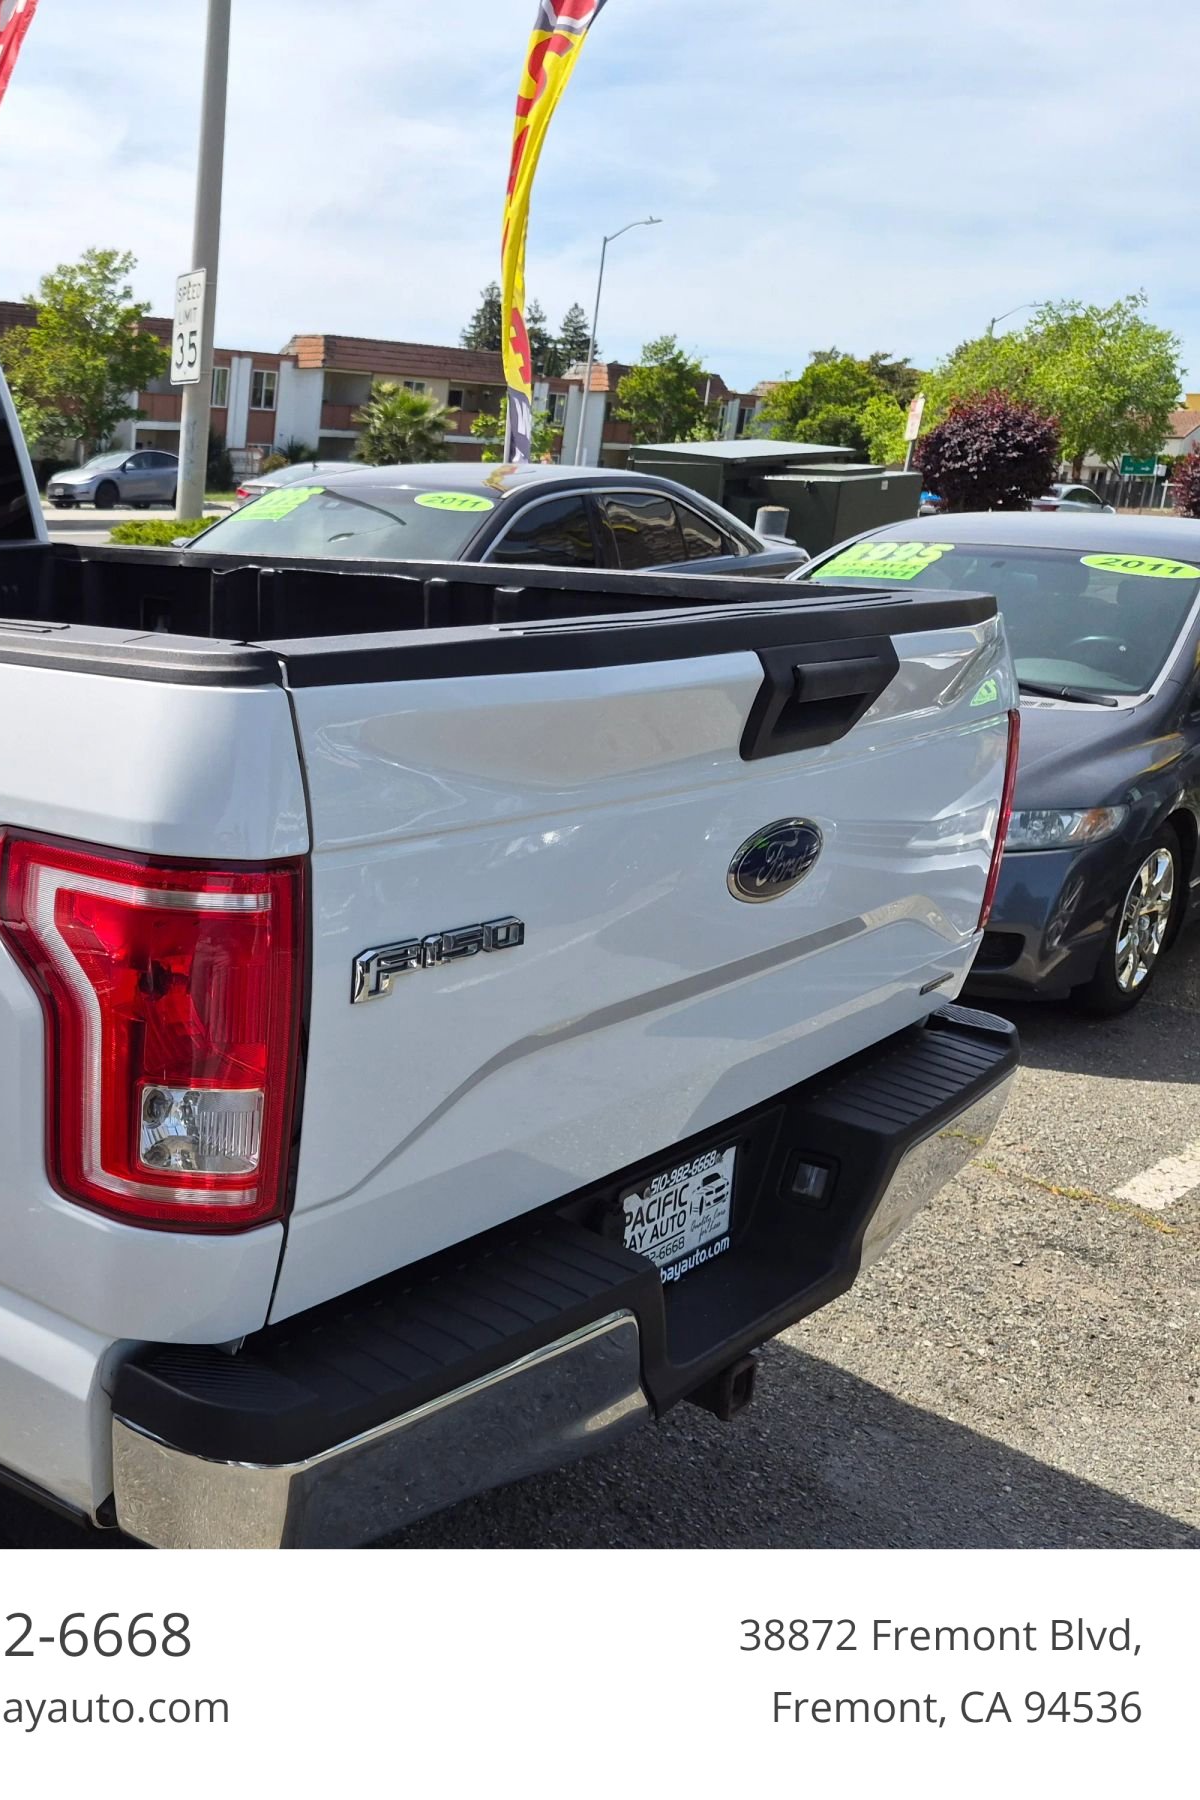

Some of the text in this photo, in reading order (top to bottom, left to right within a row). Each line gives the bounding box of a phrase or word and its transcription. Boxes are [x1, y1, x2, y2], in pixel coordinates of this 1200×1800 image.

[177, 282, 201, 302] SPEED
[177, 307, 198, 326] LIMIT
[175, 330, 198, 369] 35
[424, 495, 483, 509] 2011
[1096, 557, 1184, 574] 2011
[650, 1150, 718, 1196] 510-982-6668
[624, 1182, 689, 1233] PACIFIC
[649, 1209, 687, 1244] AUTO
